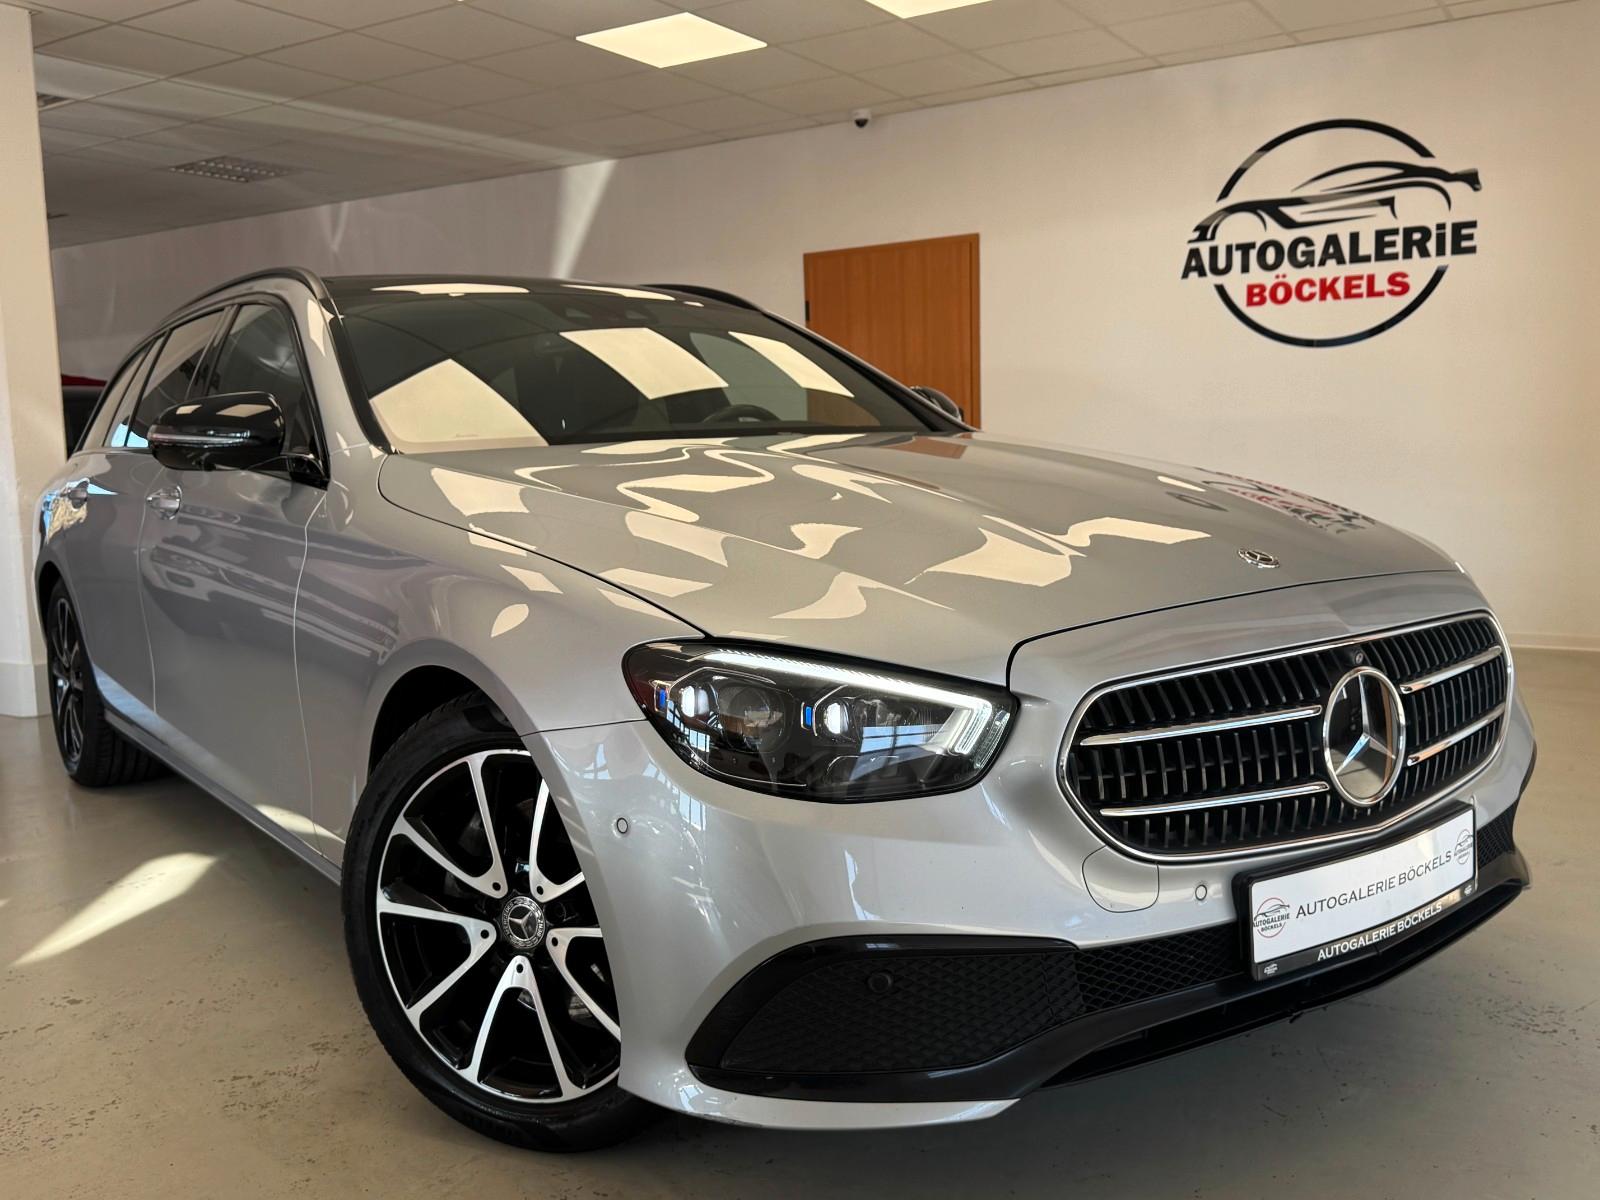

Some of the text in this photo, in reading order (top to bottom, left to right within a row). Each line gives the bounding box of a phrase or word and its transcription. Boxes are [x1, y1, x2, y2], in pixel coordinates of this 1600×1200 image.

[1246, 272, 1411, 307] BÖCKELS
[1295, 850, 1452, 919] AUTOGALERIE BÖCKELS
[1317, 902, 1443, 961] AUTOGALERIE BÖCKELS
